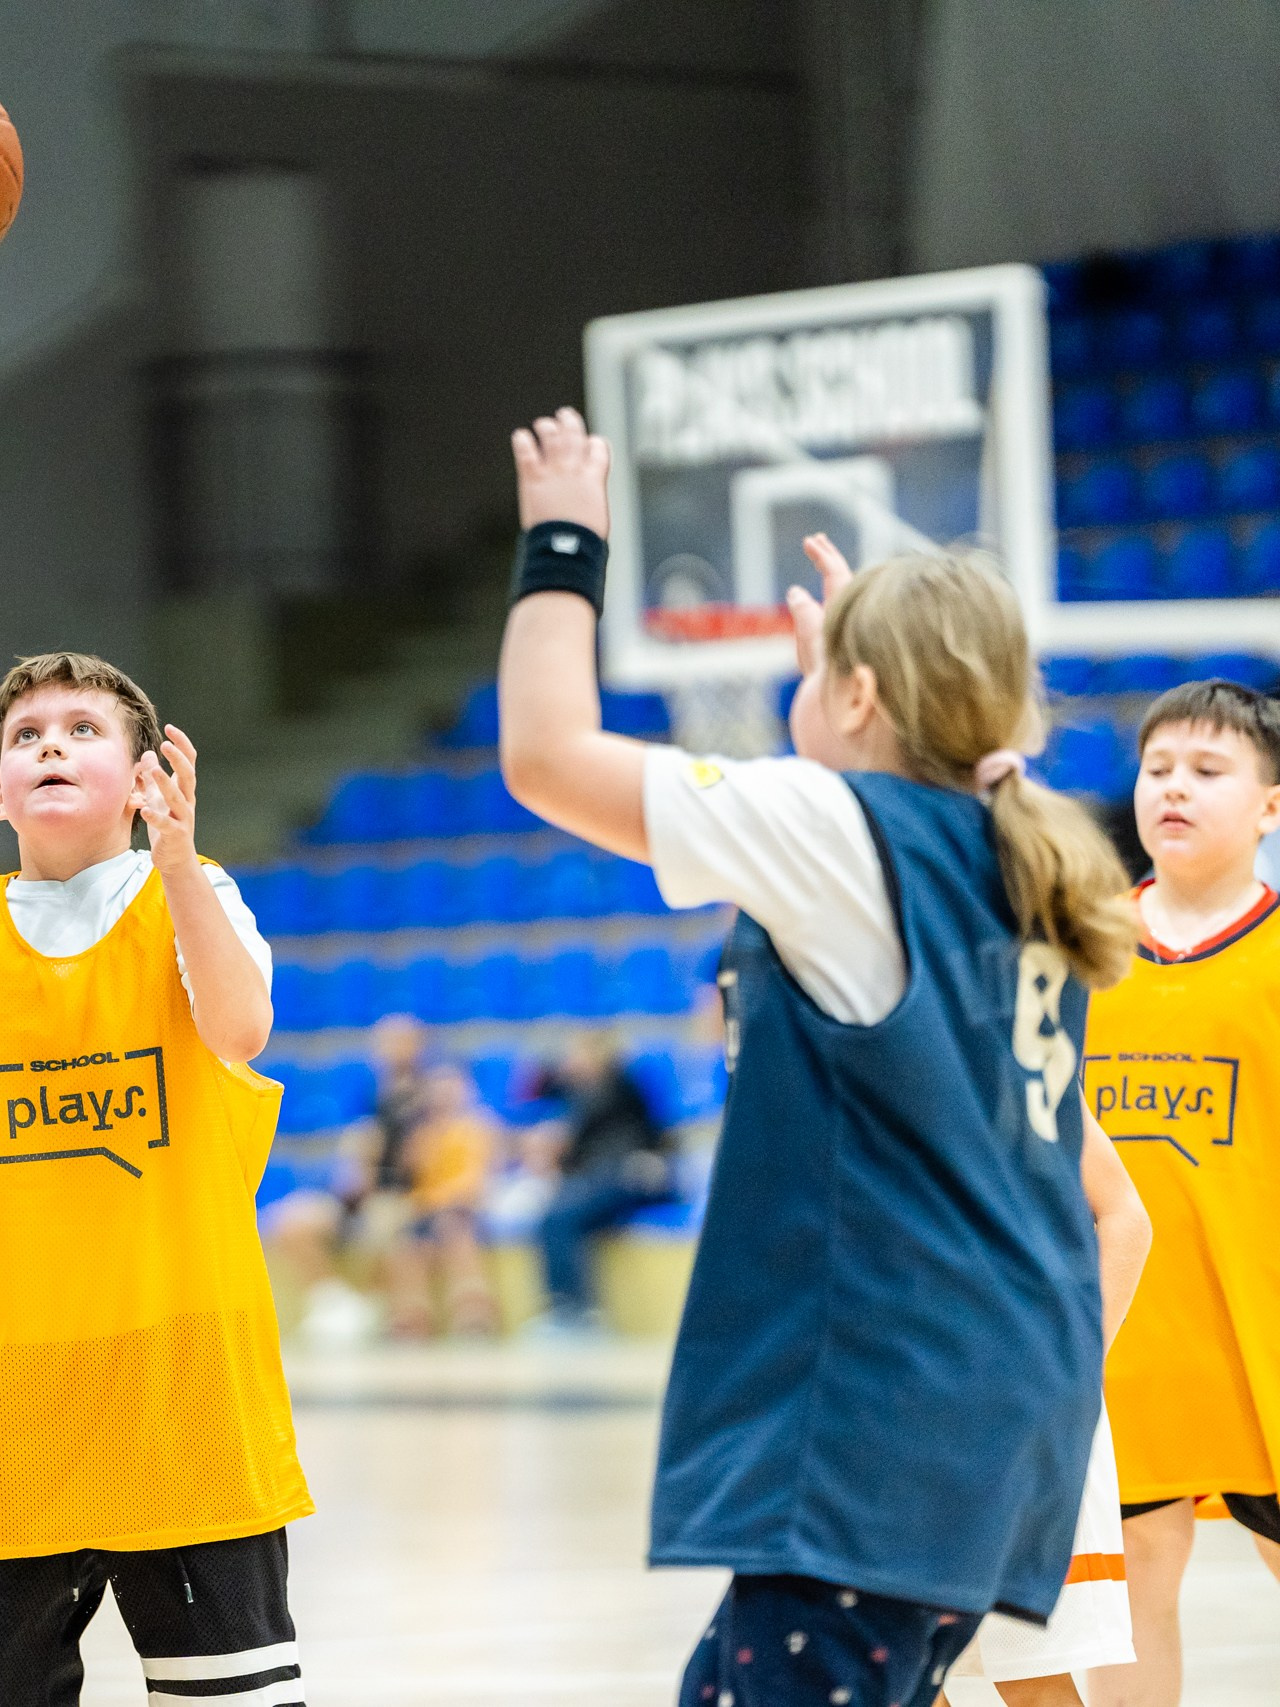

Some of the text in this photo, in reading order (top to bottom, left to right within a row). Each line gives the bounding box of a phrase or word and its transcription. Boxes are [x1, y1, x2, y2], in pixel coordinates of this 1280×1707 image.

[30, 1051, 120, 1072] SCHOOL
[7, 1085, 147, 1139] plays.
[1096, 1074, 1214, 1121] plays.
